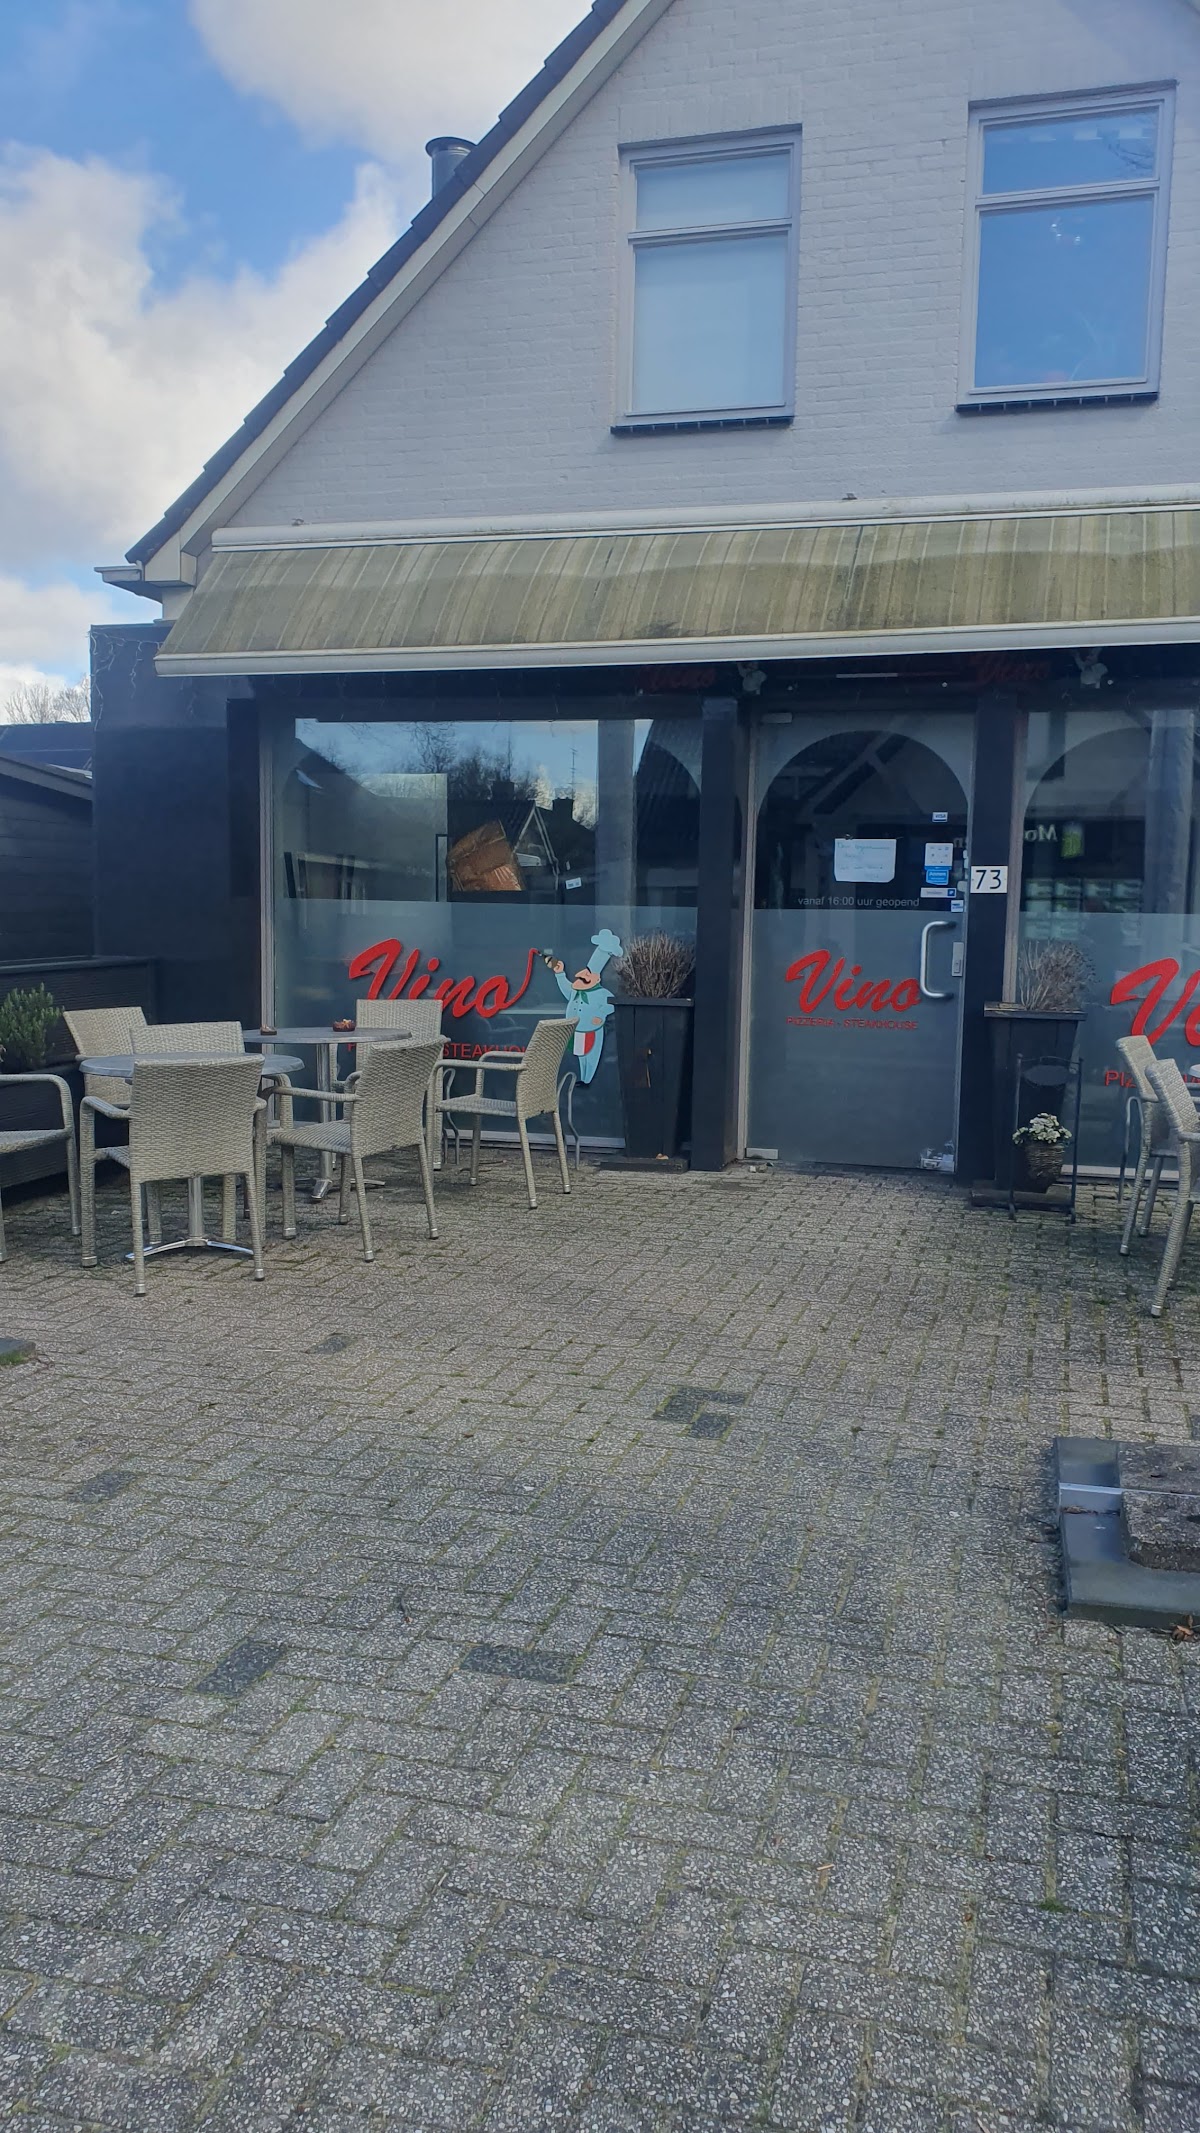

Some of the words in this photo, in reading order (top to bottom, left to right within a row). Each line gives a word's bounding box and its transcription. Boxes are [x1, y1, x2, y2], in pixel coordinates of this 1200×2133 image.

[975, 869, 1002, 890] 73
[797, 896, 825, 906] vanaf
[827, 896, 855, 906] 16:00
[857, 898, 873, 906] uur
[875, 897, 920, 908] geopend
[348, 937, 538, 1018] Vino
[785, 949, 922, 1013] Vino
[785, 1016, 834, 1027] PIZZERIA
[843, 1017, 919, 1030] STEAKHOUSE
